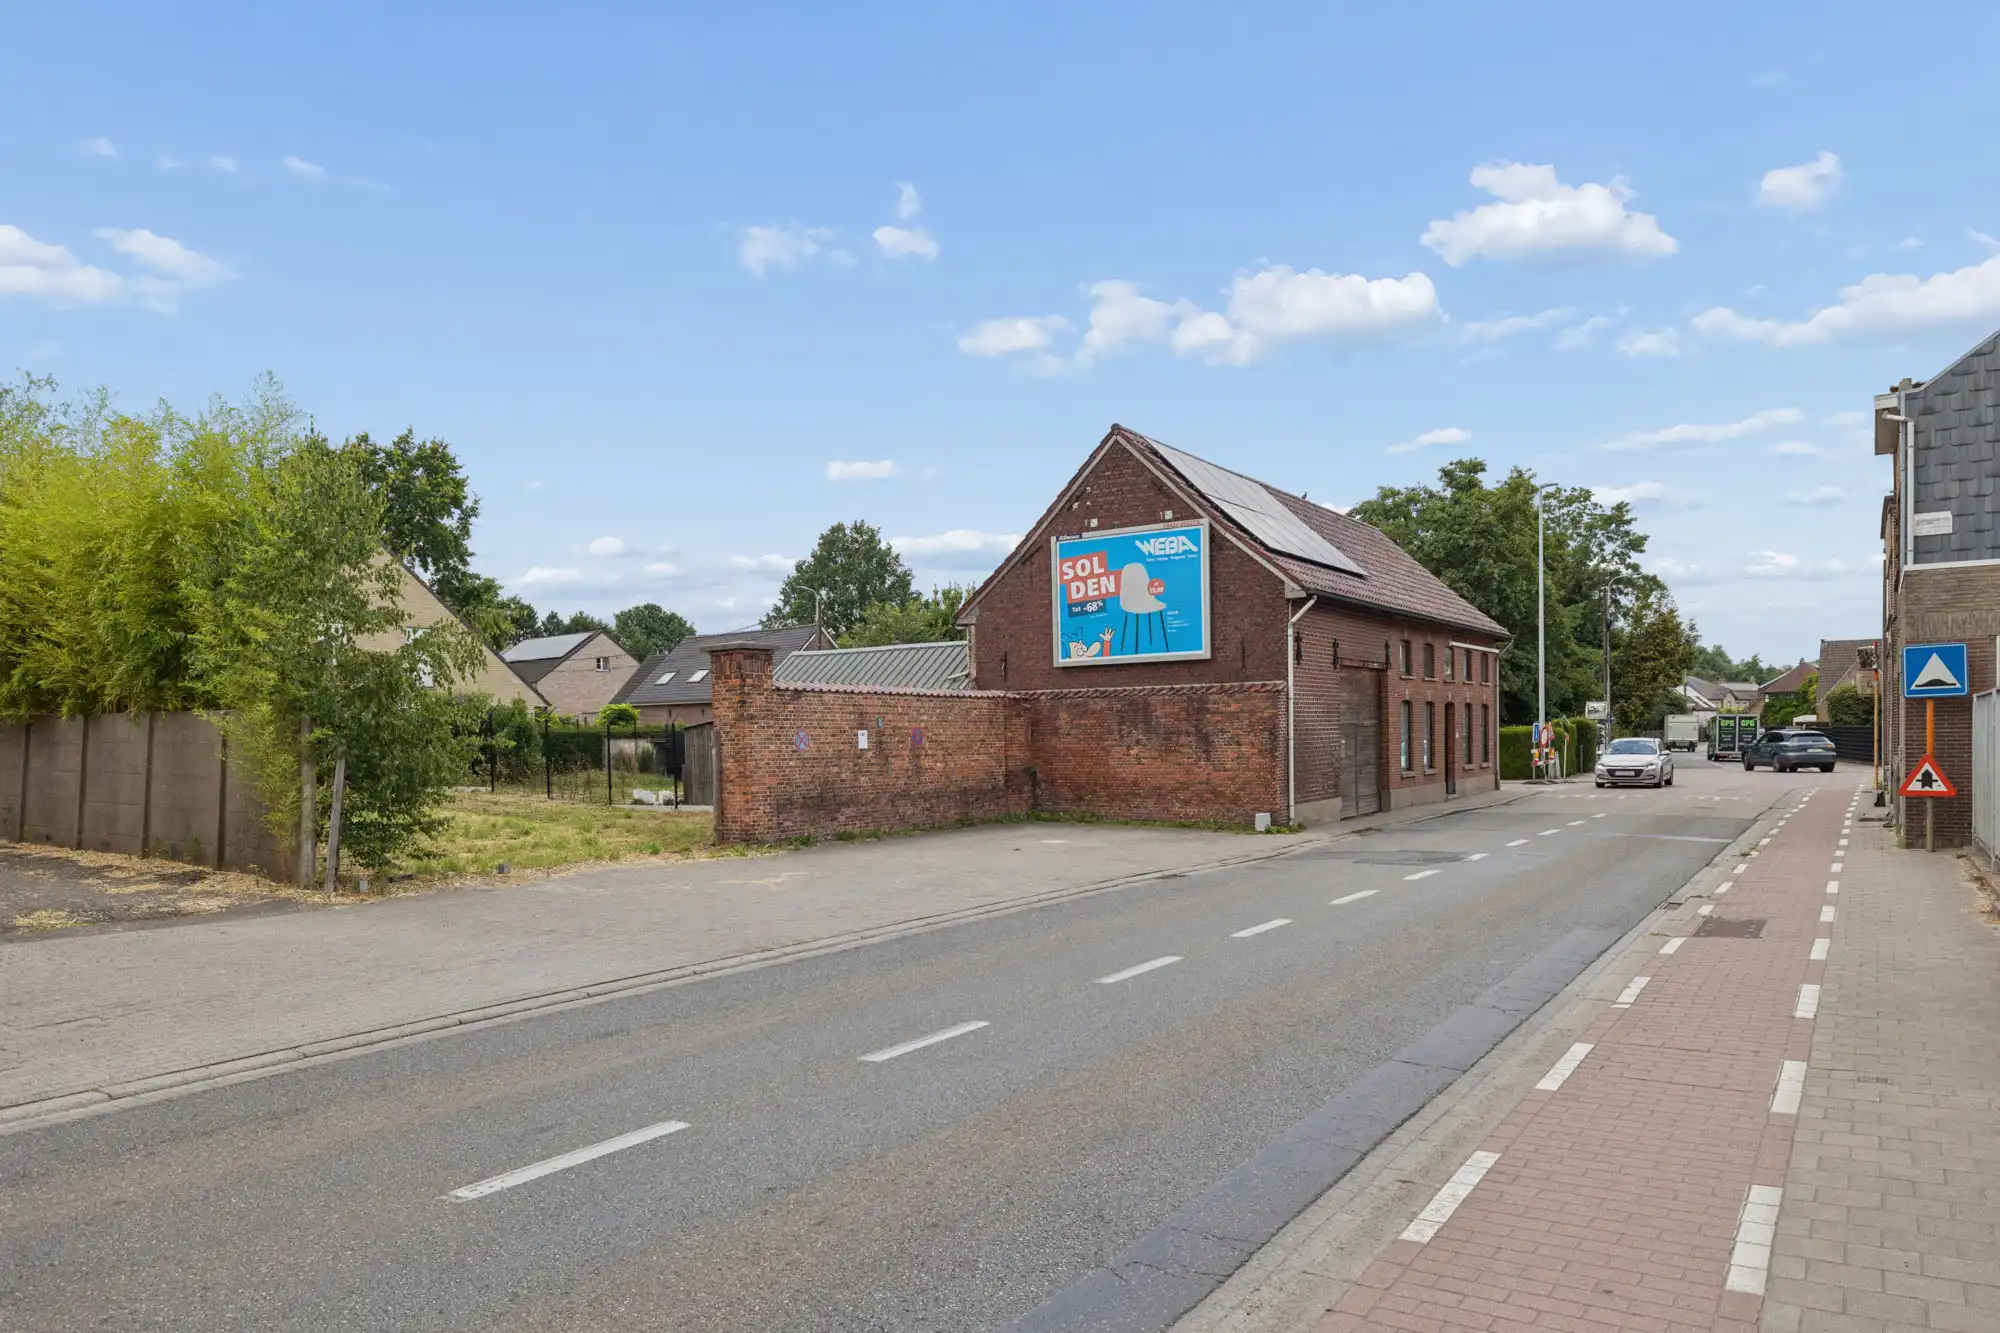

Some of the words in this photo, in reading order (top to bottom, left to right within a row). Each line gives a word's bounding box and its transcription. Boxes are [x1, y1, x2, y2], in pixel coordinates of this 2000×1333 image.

[1135, 535, 1198, 556] WEBA
[1062, 556, 1105, 580] SOL
[1070, 574, 1116, 600] DEN
